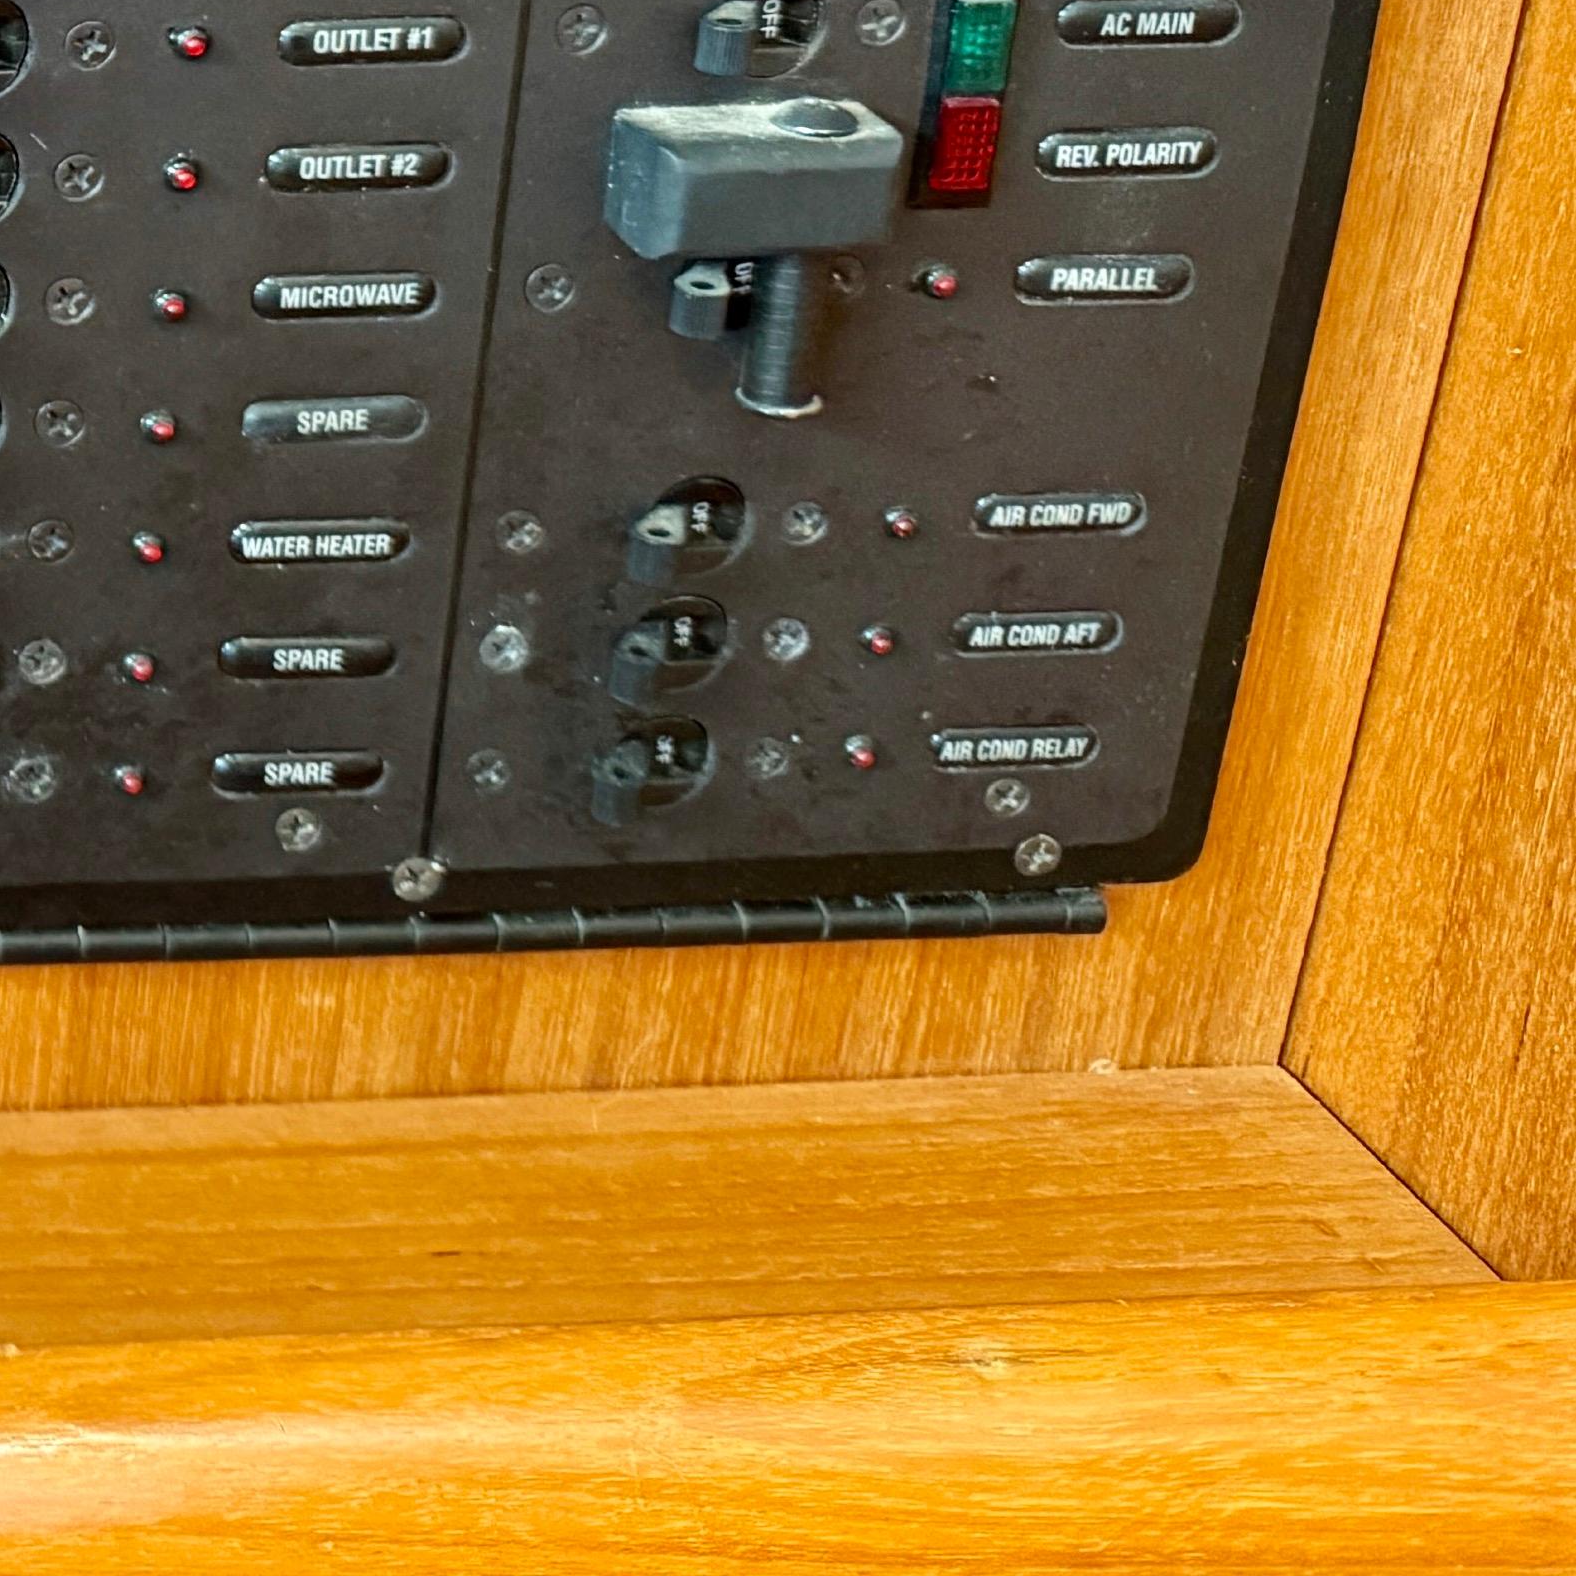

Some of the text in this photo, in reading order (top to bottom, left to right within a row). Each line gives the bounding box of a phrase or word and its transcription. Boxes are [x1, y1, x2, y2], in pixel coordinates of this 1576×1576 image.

[761, 0, 780, 38] OFF
[1100, 12, 1194, 36] AC MAIN
[313, 27, 433, 53] OUTLET #1
[300, 154, 418, 179] OUTLET #2
[1055, 142, 1202, 168] REV. POLARITY
[1051, 267, 1158, 292] PARALLEL
[280, 283, 418, 309] MICROWAVE
[297, 409, 368, 433] SPARE
[990, 502, 1132, 526] AIR COND FWD
[242, 533, 390, 558] WATER HEATER
[969, 622, 1101, 646] AIR COND AFT
[273, 648, 344, 671] SPARE
[941, 735, 1088, 760] AIR COND RELAY
[264, 762, 332, 784] SPARE
